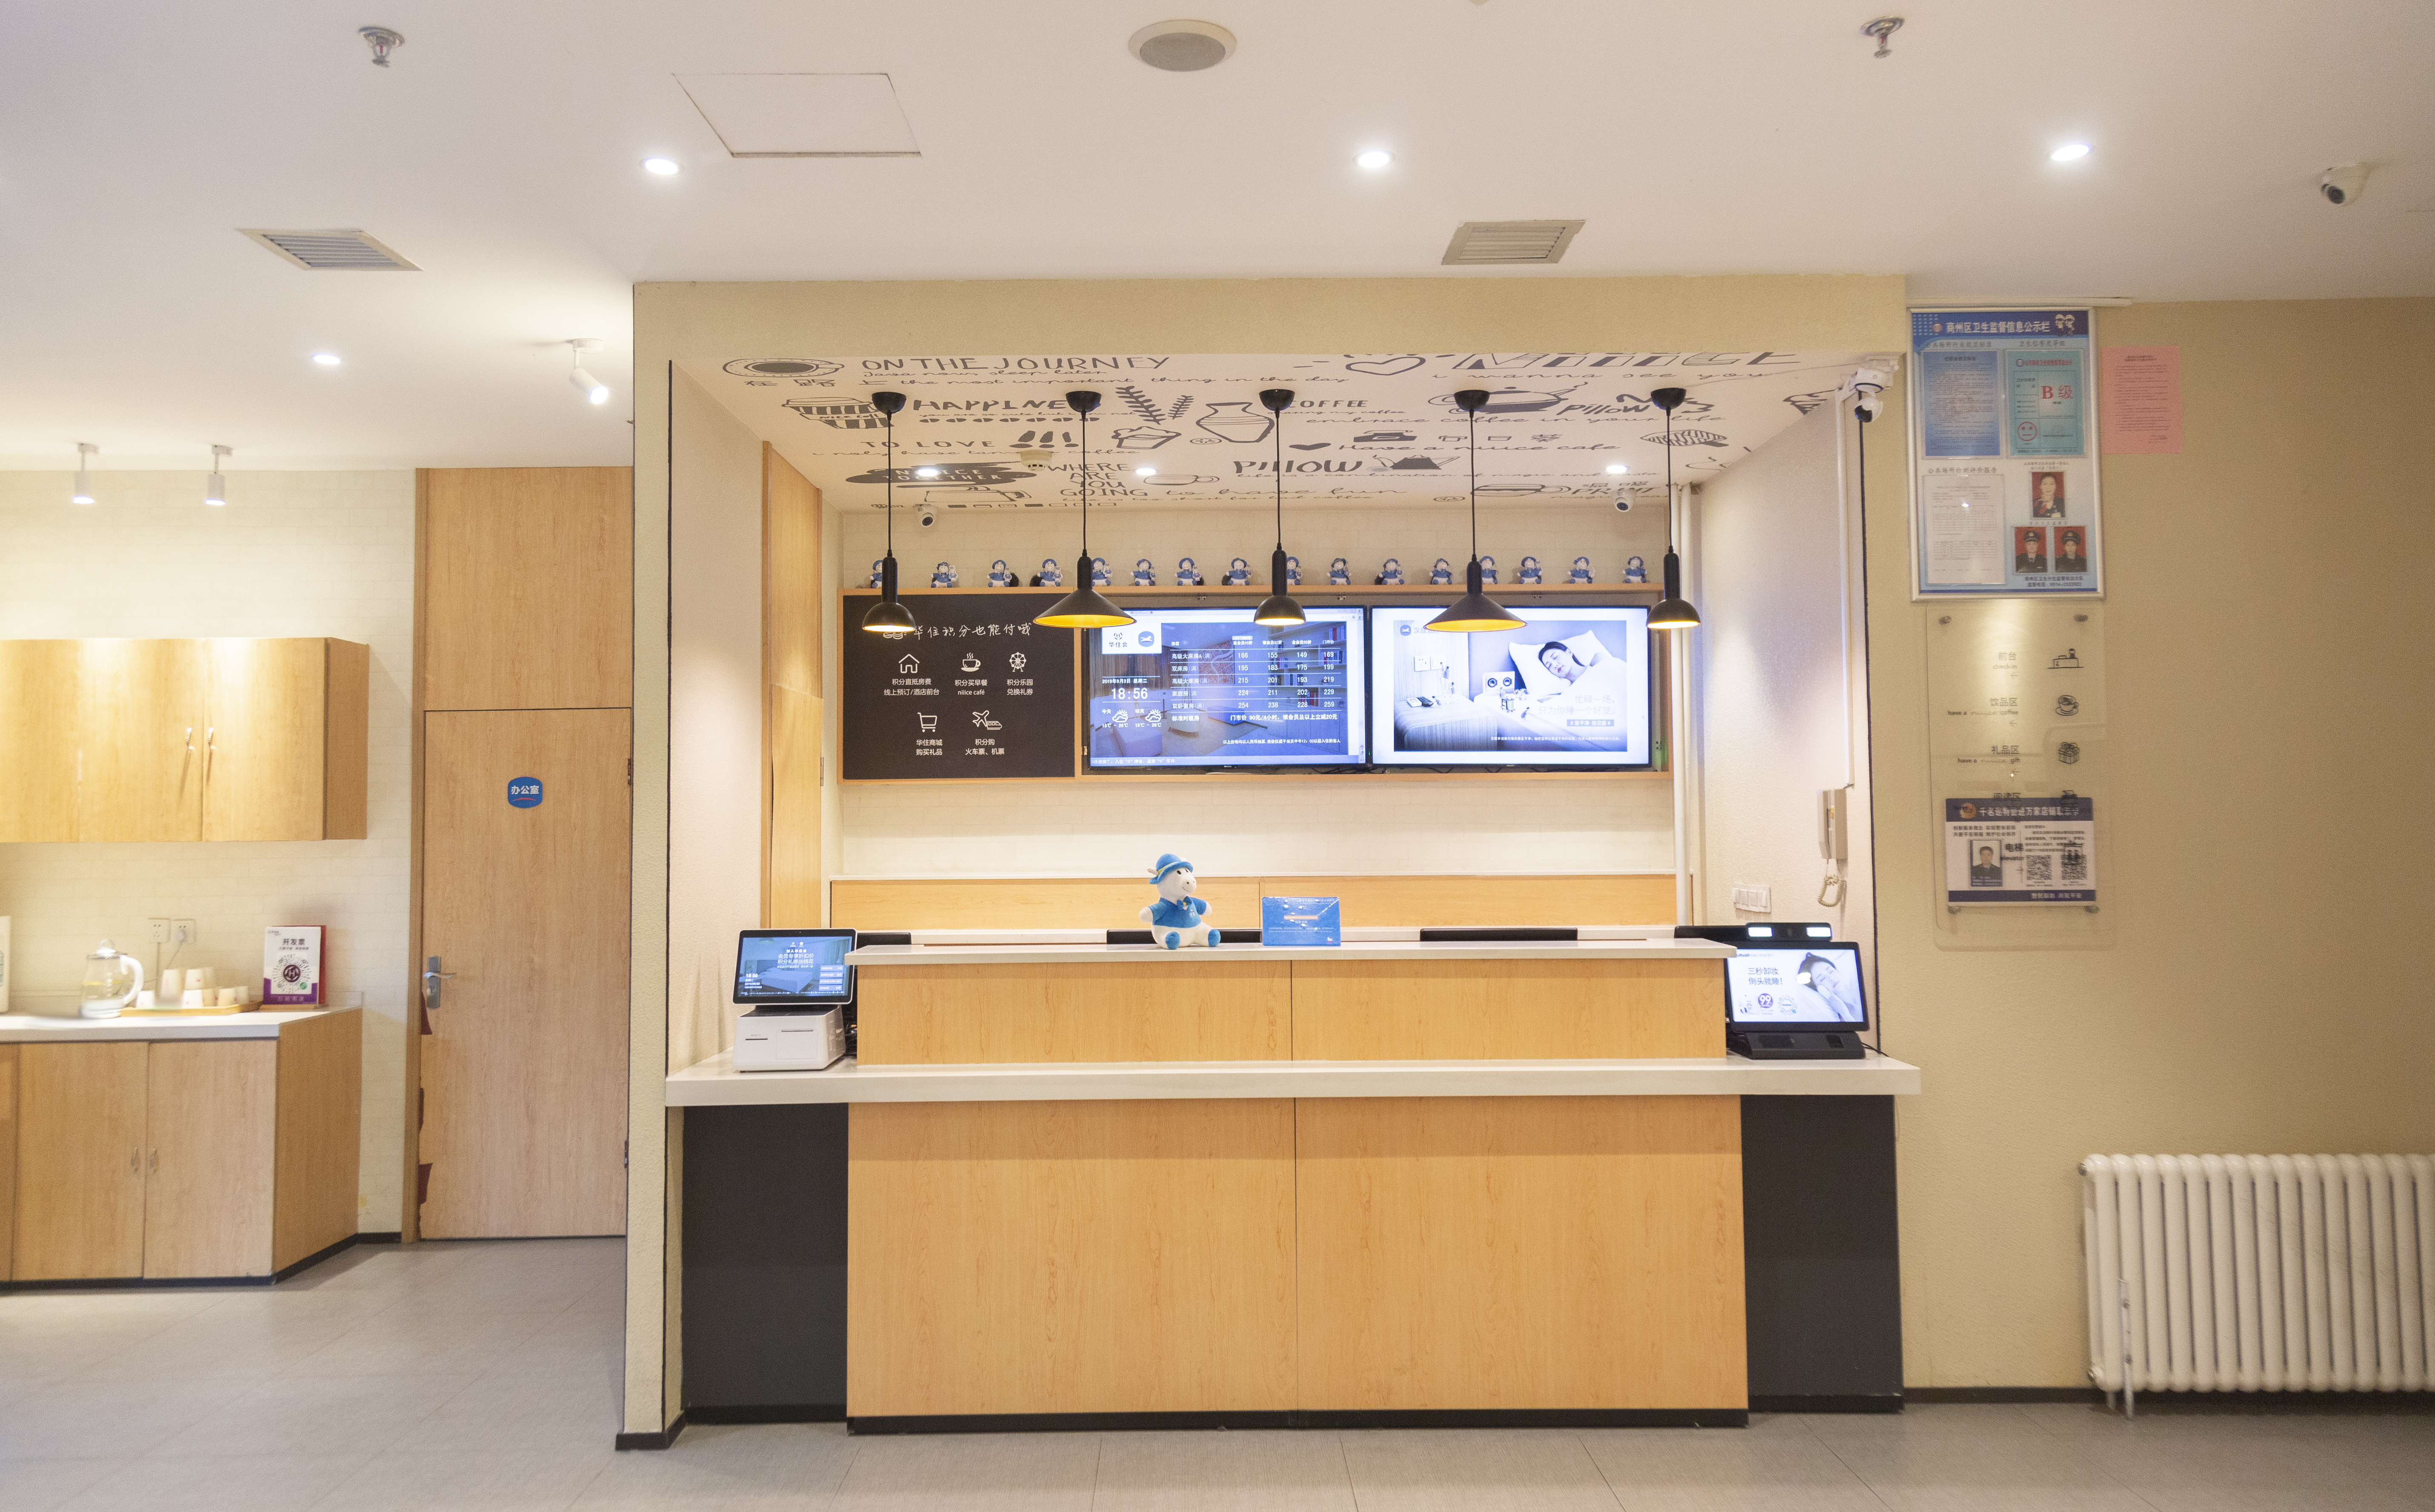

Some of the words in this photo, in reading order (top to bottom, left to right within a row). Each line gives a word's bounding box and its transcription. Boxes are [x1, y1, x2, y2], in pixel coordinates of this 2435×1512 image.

[1946, 321, 2050, 333] 商州区卫生监督信息公示栏
[862, 359, 904, 370] ON
[910, 358, 989, 370] THE
[994, 357, 1169, 370] JOURNEY
[2041, 386, 2054, 399] B
[2058, 385, 2073, 399] 级
[1048, 463, 1132, 472] WHERE
[1069, 472, 1119, 480] ARE
[1060, 488, 1148, 496] GOING
[1329, 487, 1407, 495] fun
[914, 623, 1033, 640] 华住积分也能付哦
[1998, 652, 2017, 661] 前台
[1111, 688, 1148, 700] 18:56
[1990, 697, 2018, 707] 饮品区
[1992, 746, 2020, 755] 礼品区
[511, 785, 539, 795] 办公室
[2005, 843, 2024, 852] 电梯
[1748, 967, 1779, 975] 三秒卸妆
[1760, 995, 1772, 1005] 99
